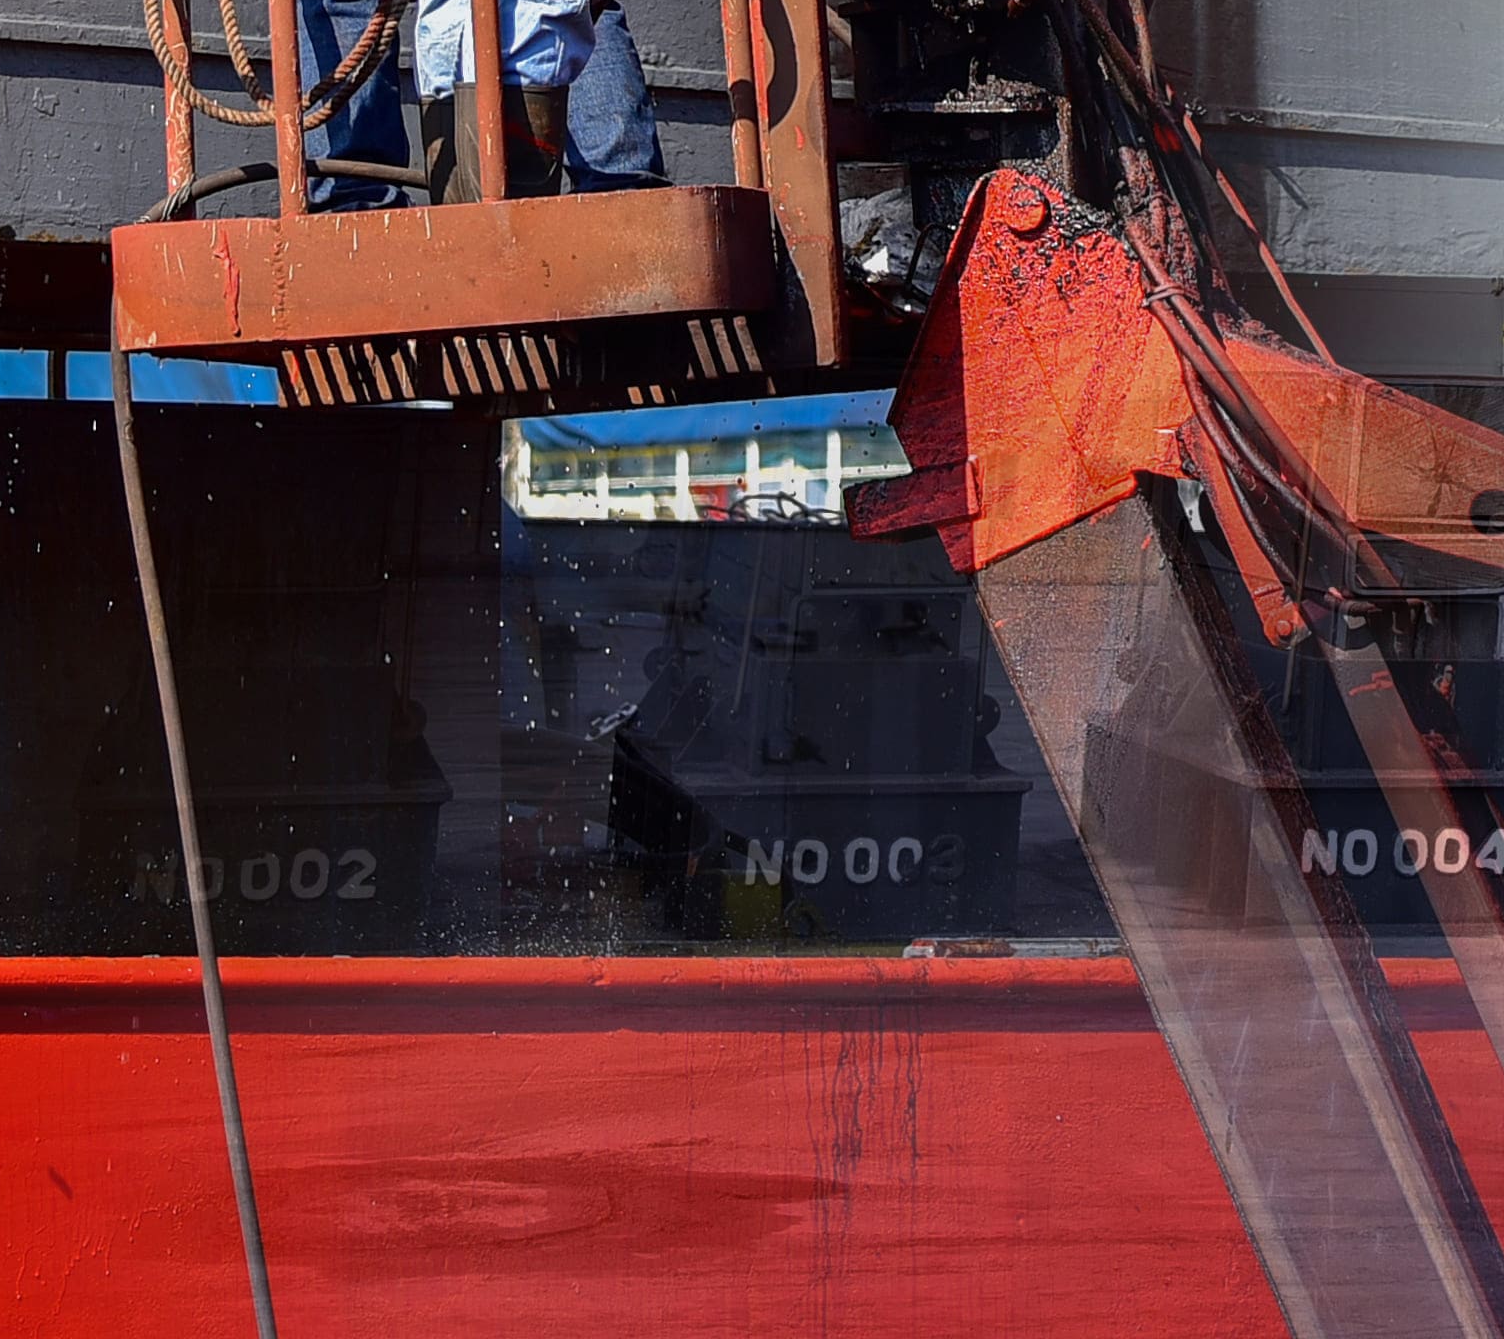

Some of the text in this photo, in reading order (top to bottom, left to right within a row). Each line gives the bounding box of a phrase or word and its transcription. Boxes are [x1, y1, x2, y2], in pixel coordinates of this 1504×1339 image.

[239, 847, 378, 903] 002
[744, 840, 828, 885] NO
[1302, 829, 1378, 876] NO
